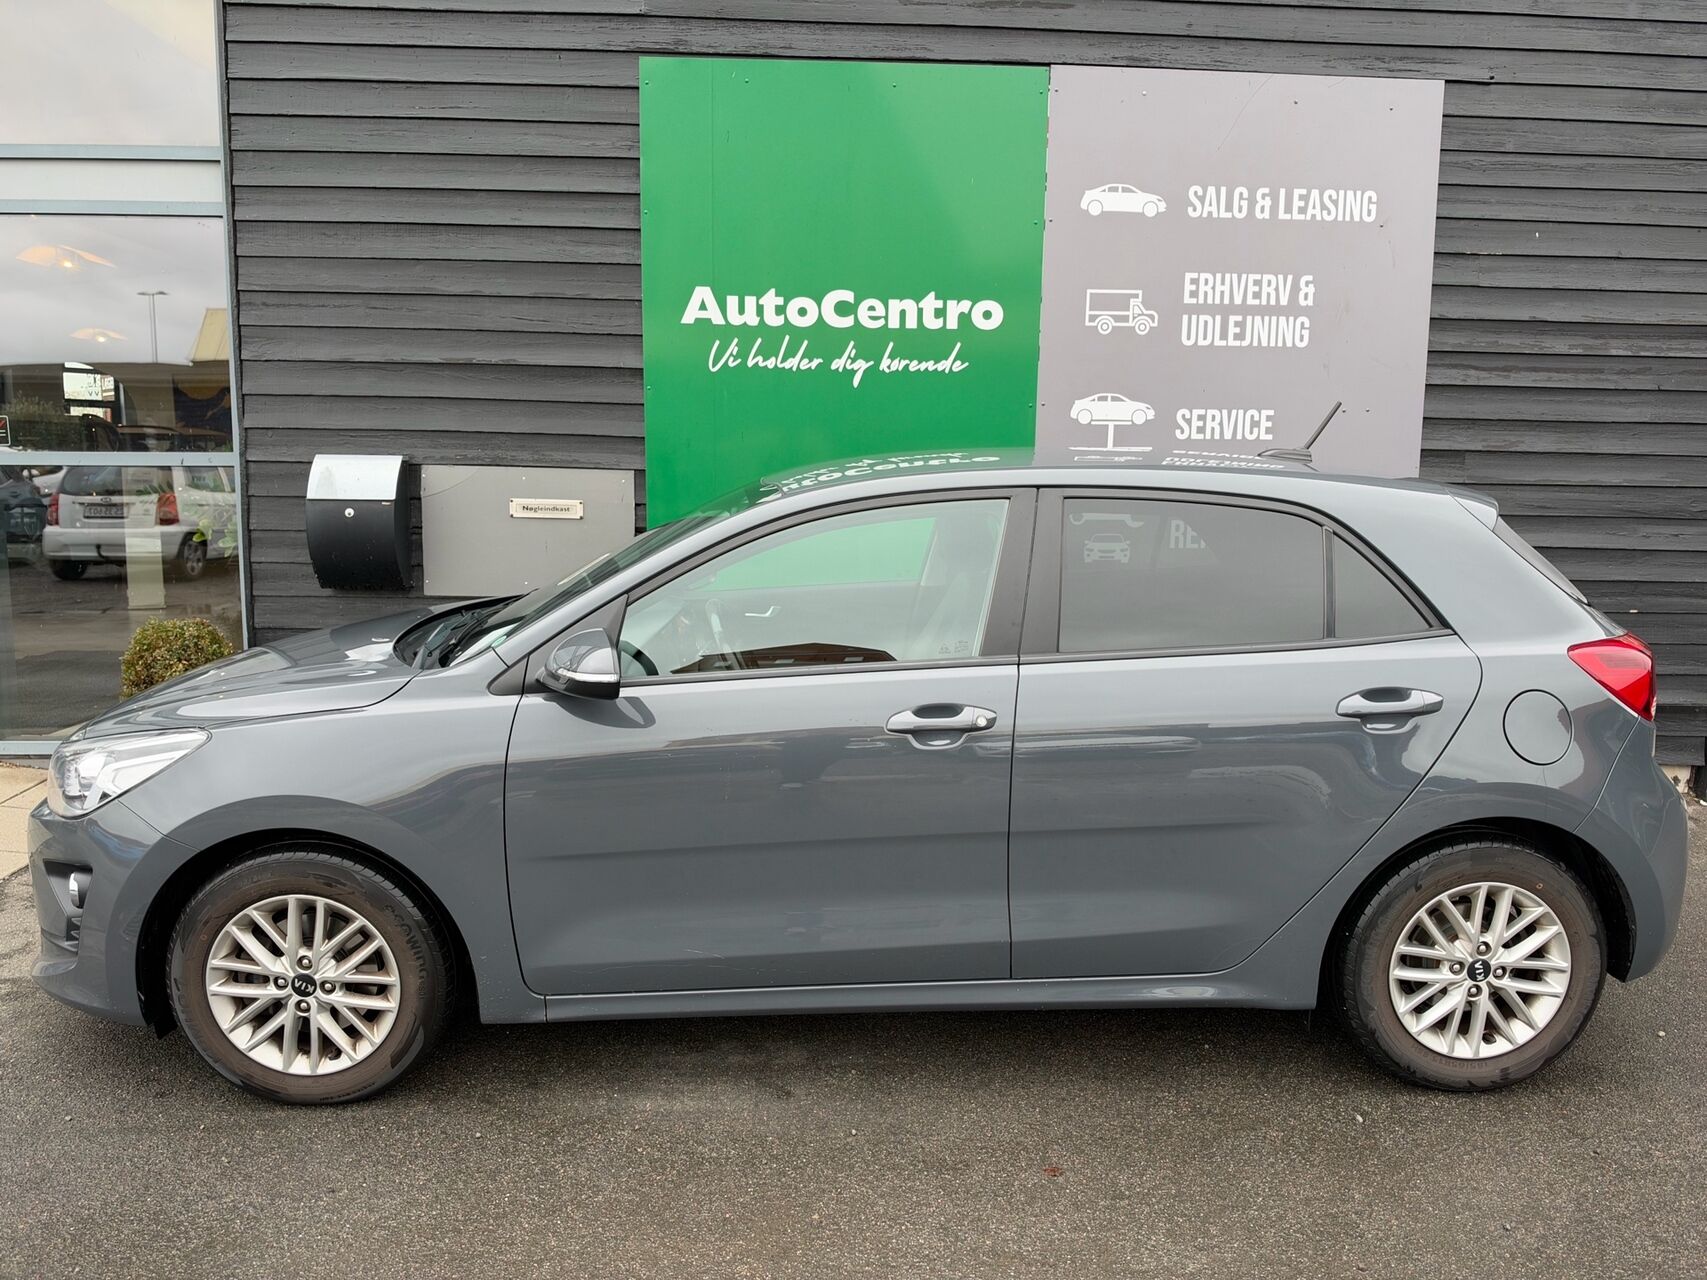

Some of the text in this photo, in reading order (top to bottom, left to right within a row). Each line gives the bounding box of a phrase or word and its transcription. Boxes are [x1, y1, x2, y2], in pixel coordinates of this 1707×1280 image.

[1187, 185, 1378, 223] SALG & LEASING
[1183, 272, 1315, 307] ERHVERV &
[679, 285, 1005, 331] AutoCentro
[1181, 314, 1310, 349] UDLEJNING
[708, 335, 969, 388] Vi holder dig kørende
[1175, 408, 1275, 441] SERVICE
[522, 505, 570, 513] Nøgleindkast
[1169, 519, 1206, 549] RE
[294, 978, 315, 994] KIA
[1474, 960, 1485, 981] KIA
